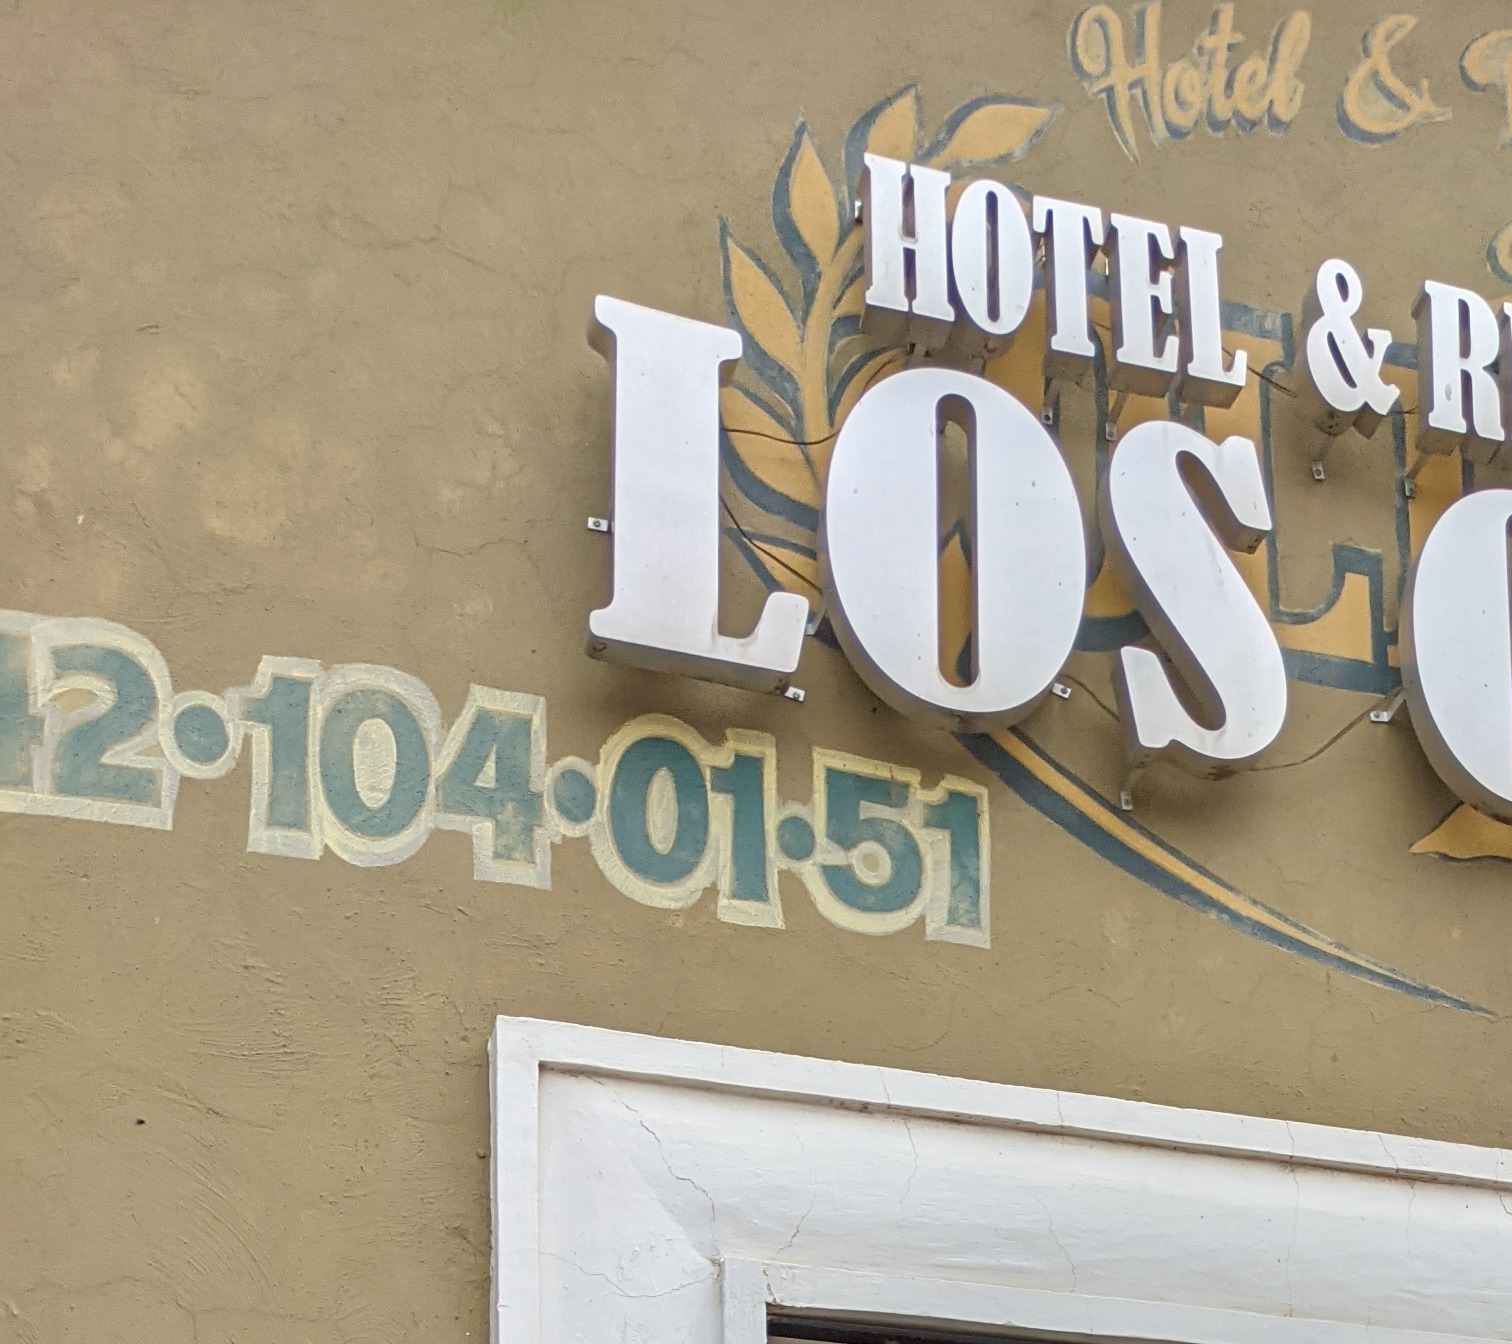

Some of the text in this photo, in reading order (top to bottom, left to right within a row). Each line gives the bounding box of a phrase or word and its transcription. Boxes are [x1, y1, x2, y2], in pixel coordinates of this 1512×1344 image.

[1067, 2, 1312, 163] Hotel
[1335, 14, 1453, 146] &
[863, 152, 1247, 387] HOTEL
[1306, 258, 1400, 416] &
[589, 294, 1288, 760] LOS
